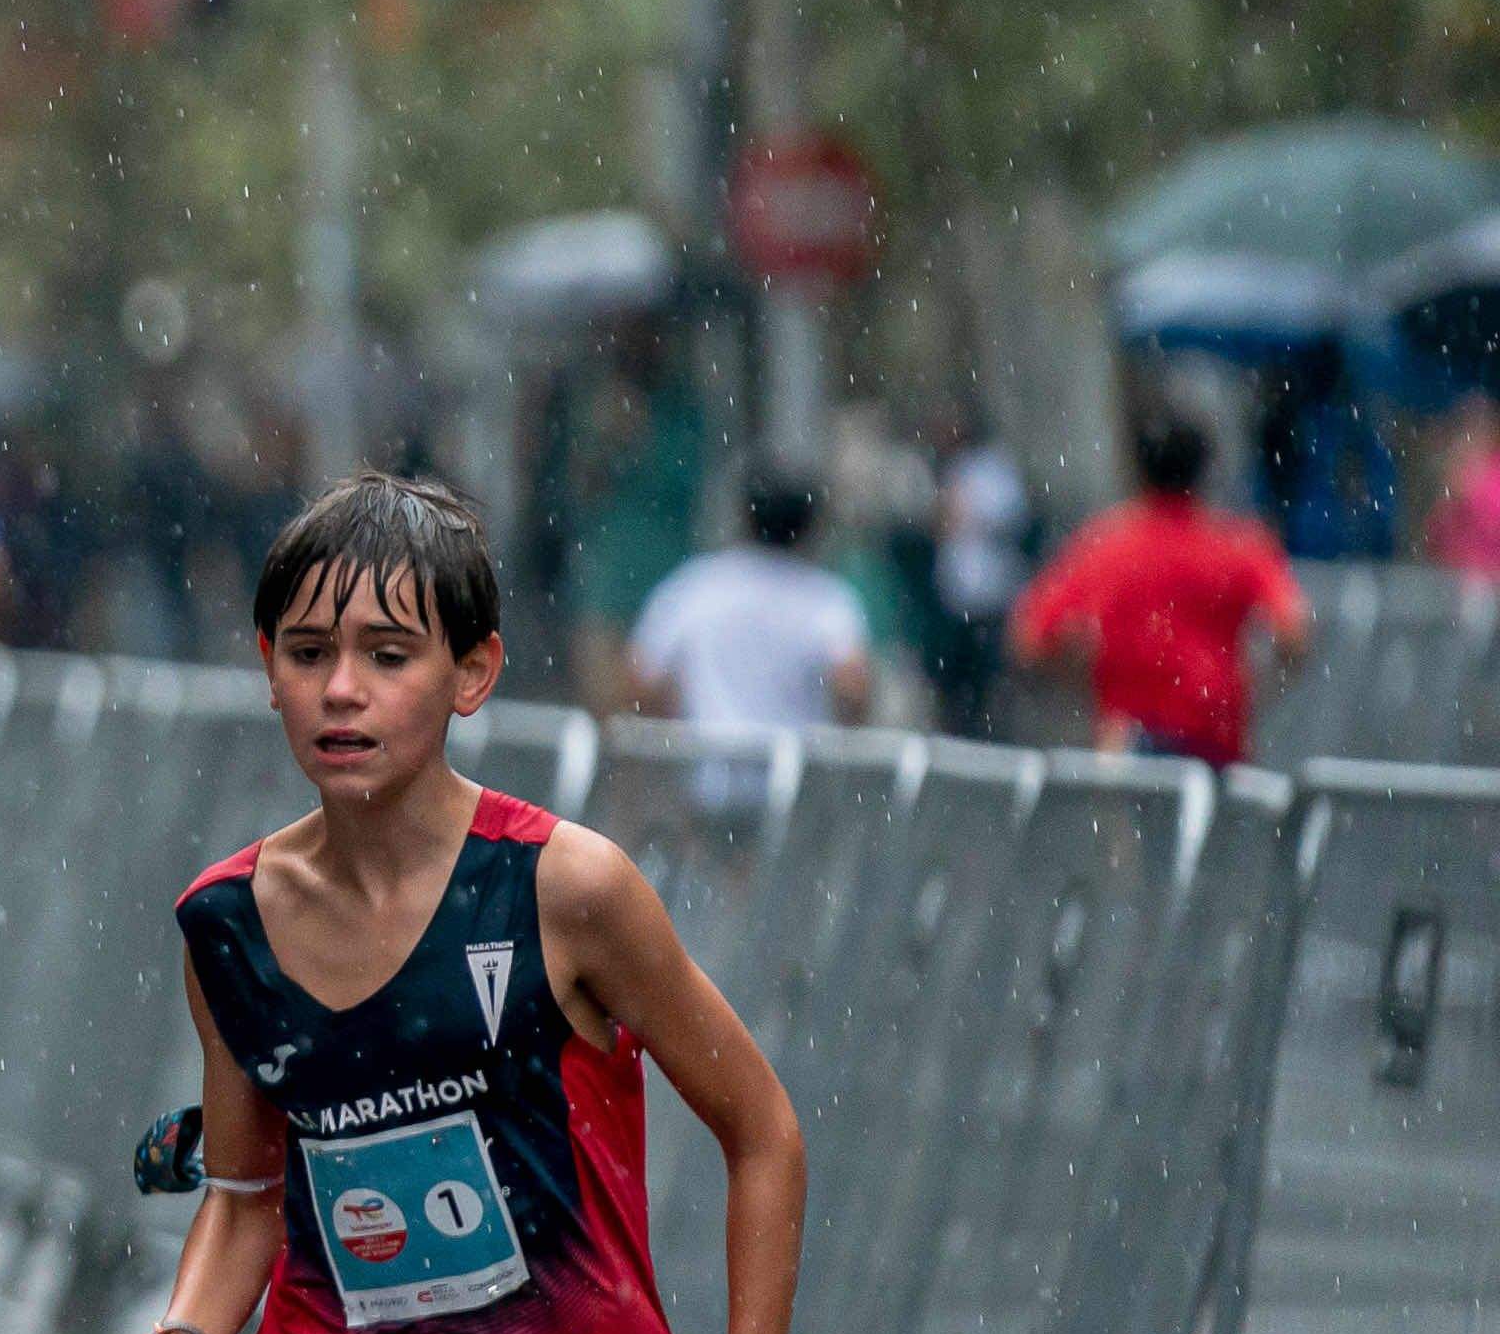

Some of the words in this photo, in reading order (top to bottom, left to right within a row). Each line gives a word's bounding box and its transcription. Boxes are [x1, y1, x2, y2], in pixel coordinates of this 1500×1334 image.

[466, 940, 514, 952] MARATHON
[320, 1069, 489, 1134] MARATHON
[437, 1187, 464, 1229] 1
